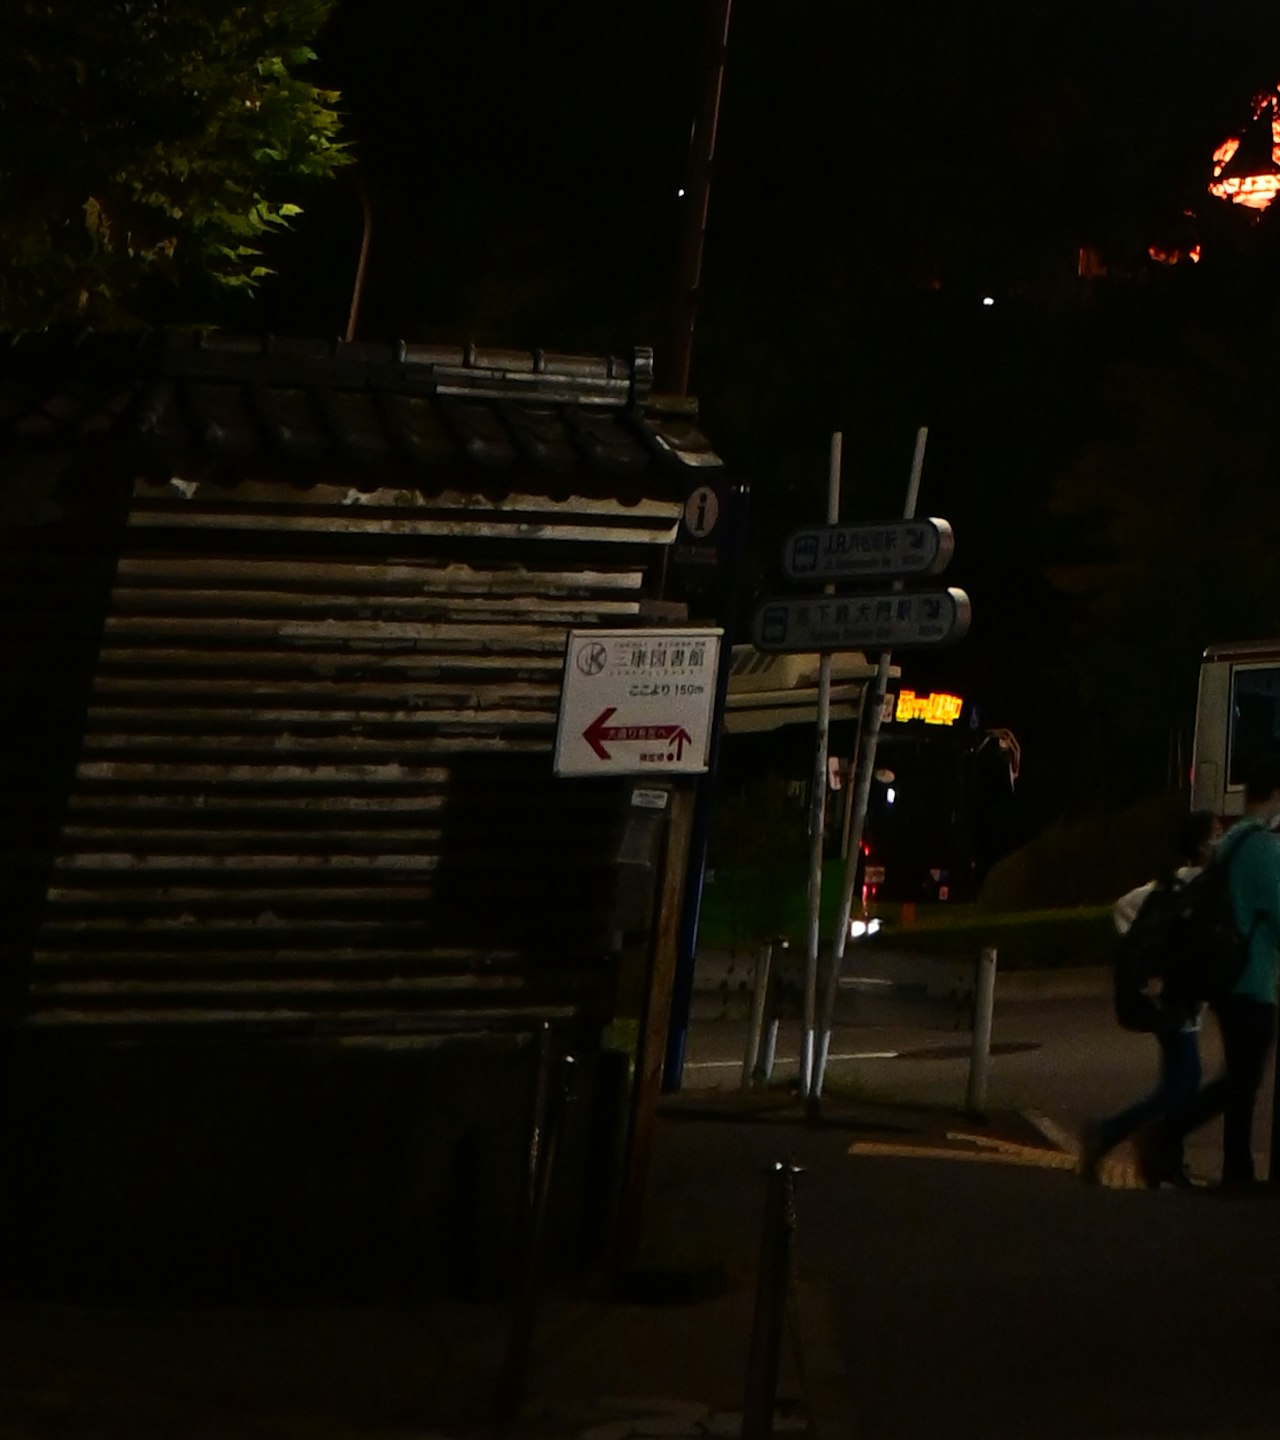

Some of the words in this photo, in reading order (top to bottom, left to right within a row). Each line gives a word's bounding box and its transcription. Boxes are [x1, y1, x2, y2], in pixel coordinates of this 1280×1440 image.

[612, 647, 705, 669] 三康図書館
[629, 683, 671, 697] ここより
[674, 684, 704, 697] 150m
